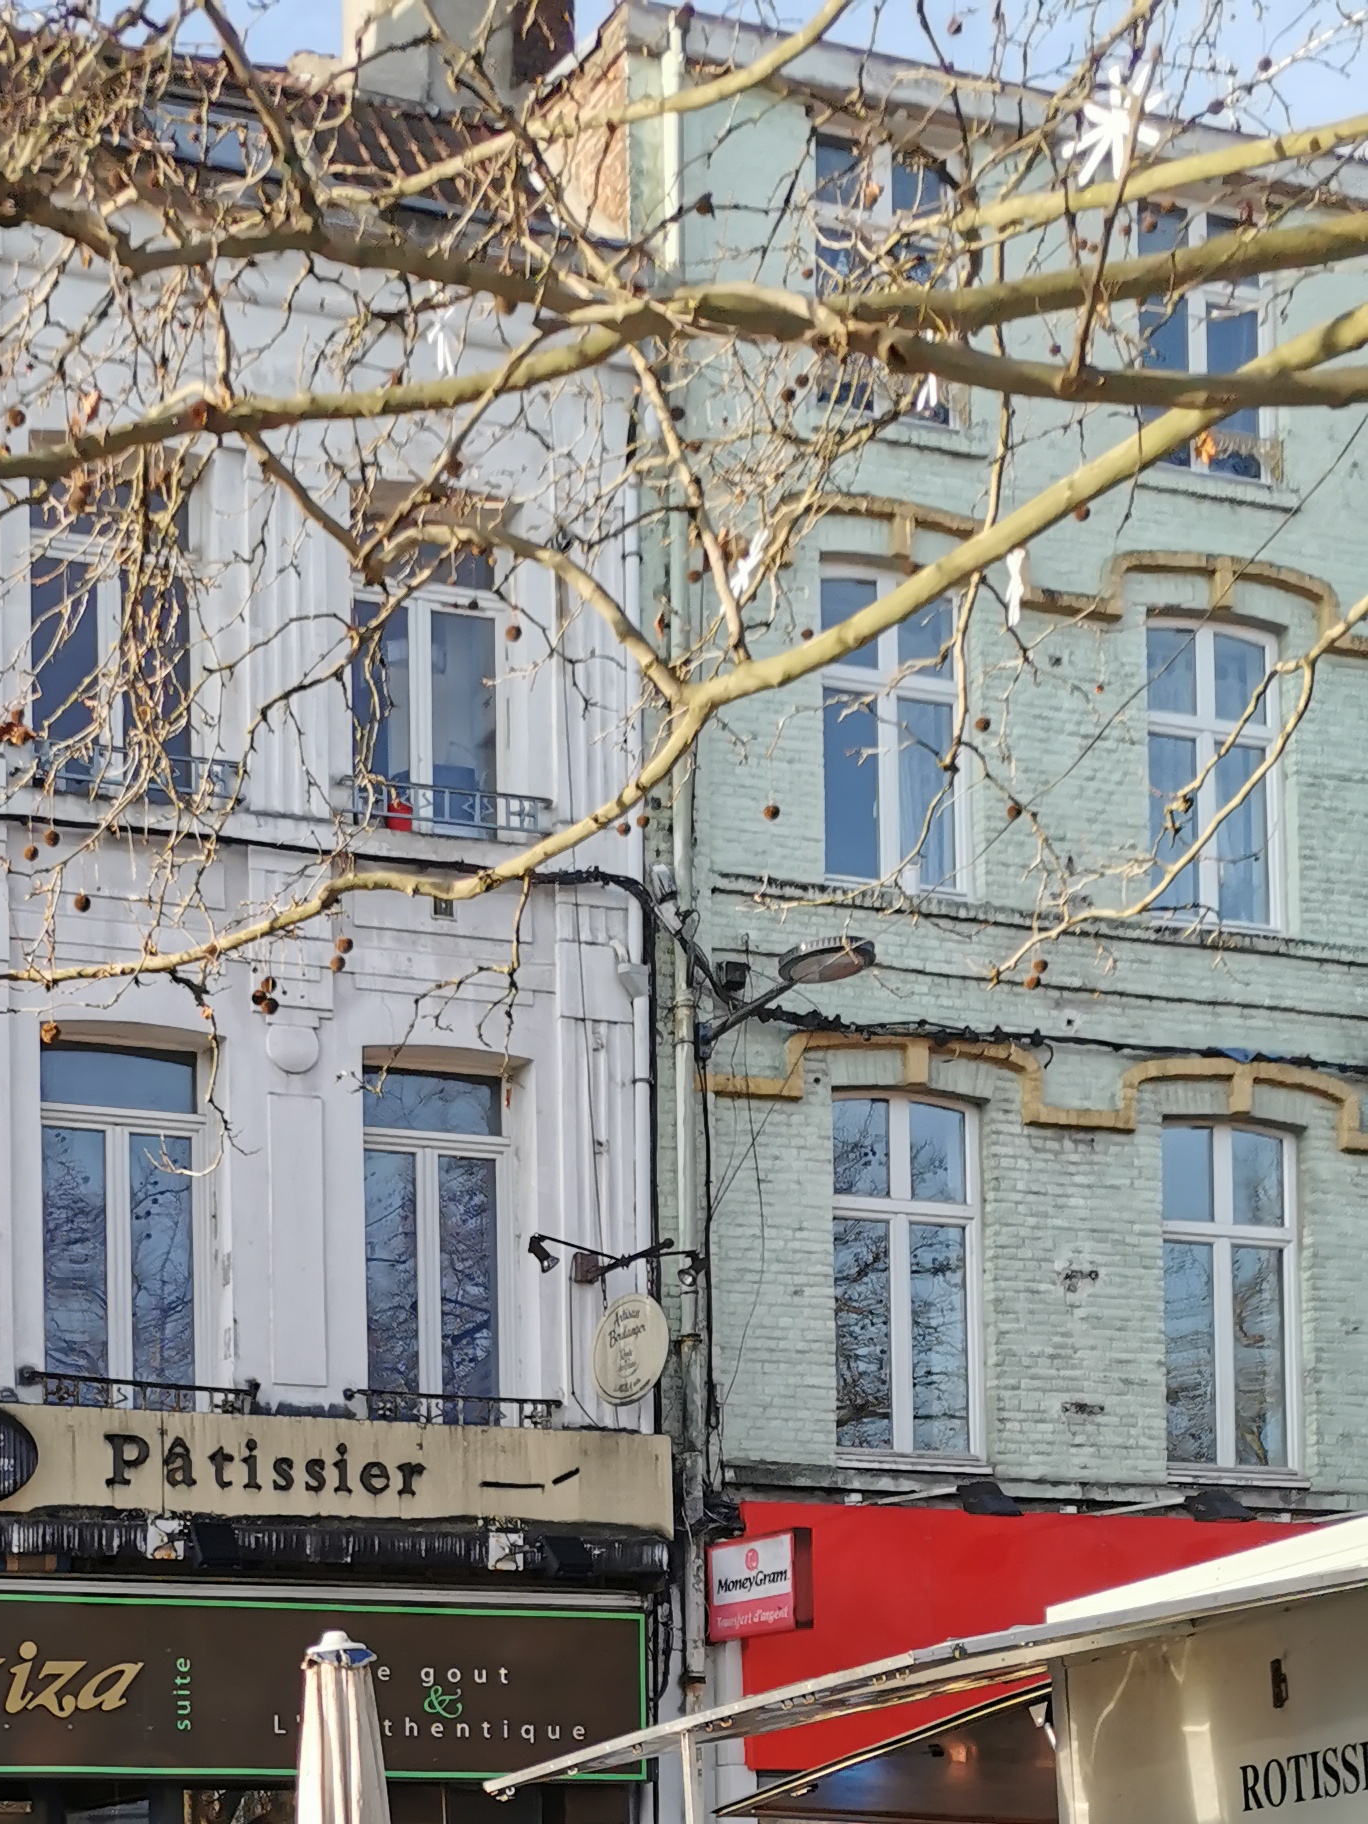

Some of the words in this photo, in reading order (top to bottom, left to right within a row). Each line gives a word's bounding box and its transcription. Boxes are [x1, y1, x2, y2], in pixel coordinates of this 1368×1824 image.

[104, 1433, 427, 1498] Pâtissier
[717, 1569, 788, 1595] MoneyGram
[419, 1665, 510, 1687] gout
[171, 1656, 192, 1731] suite
[423, 1685, 463, 1719] &
[273, 1714, 588, 1744] L'thentique
